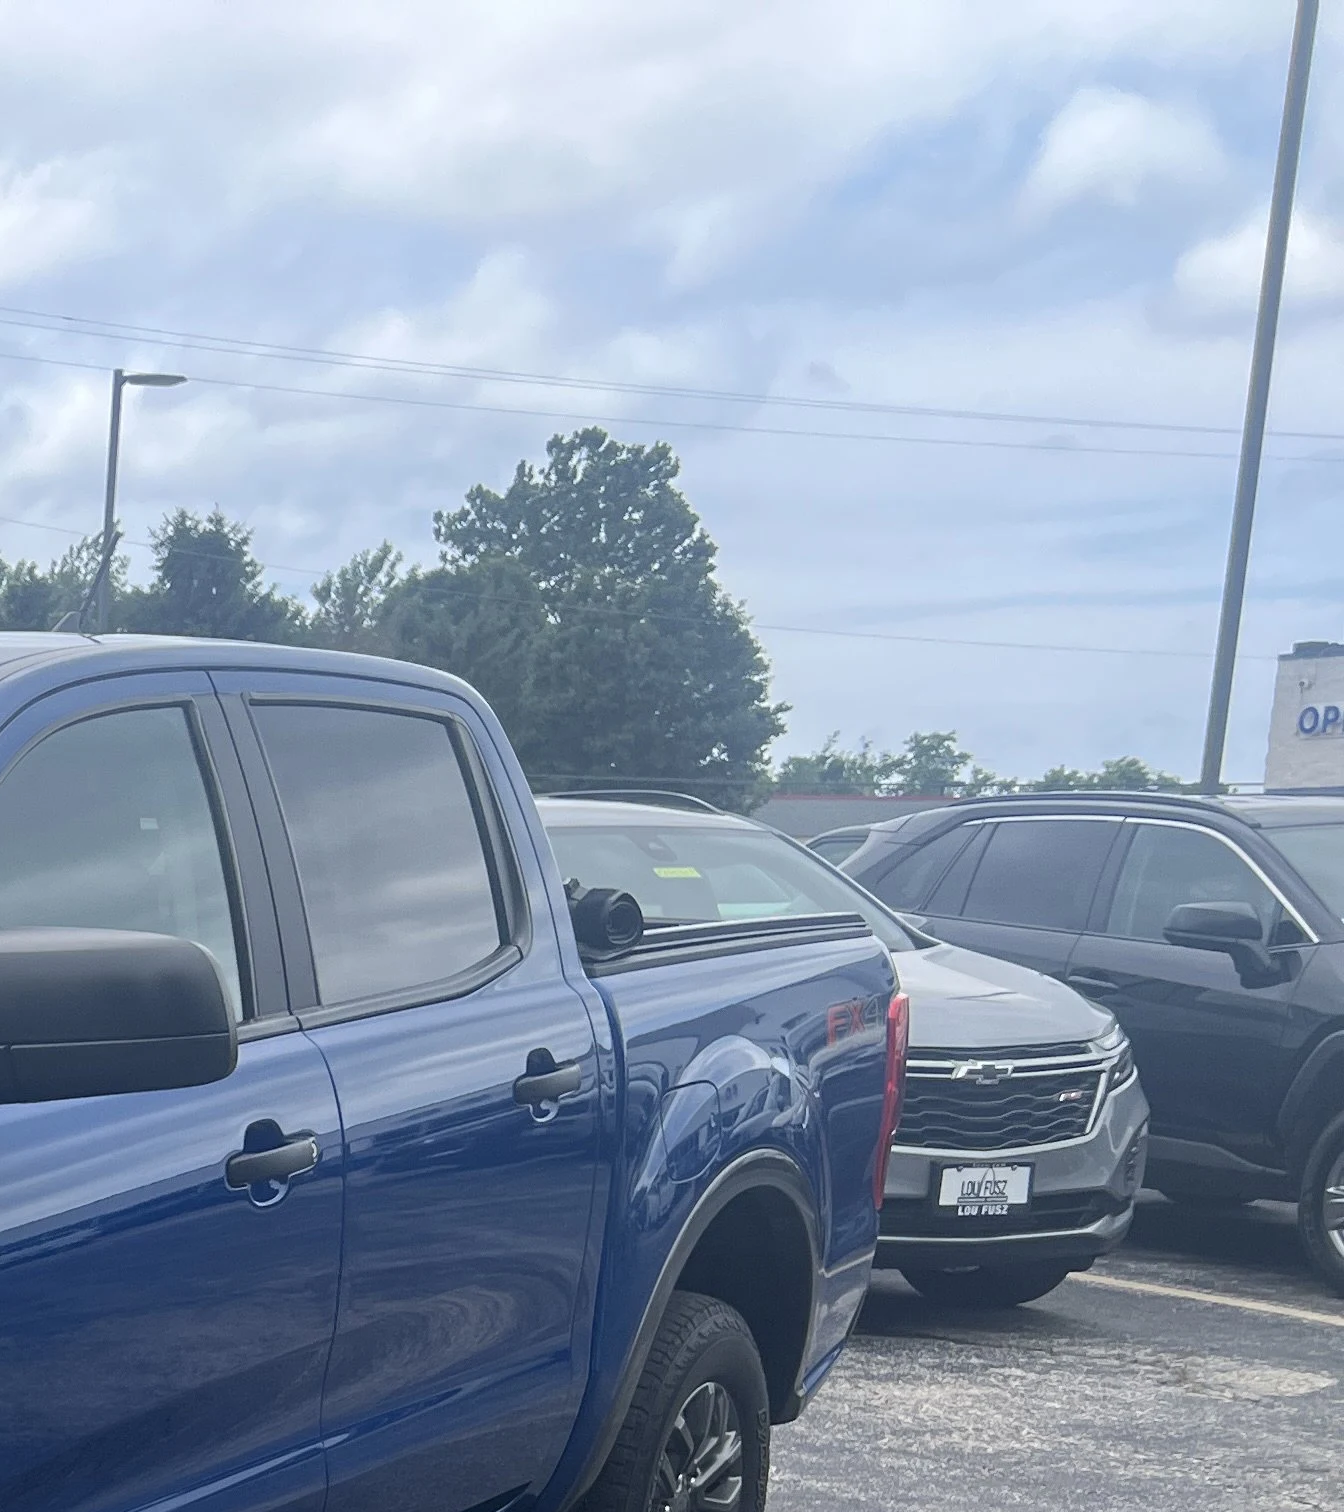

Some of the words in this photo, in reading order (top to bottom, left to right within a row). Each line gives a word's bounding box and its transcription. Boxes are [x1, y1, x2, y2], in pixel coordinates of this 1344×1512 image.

[1299, 706, 1344, 734] OP
[826, 993, 882, 1047] FX4
[961, 1180, 980, 1196] LOU
[984, 1180, 1007, 1196] FUSZ
[957, 1205, 979, 1216] LOU
[981, 1204, 1009, 1216] FUSZ
